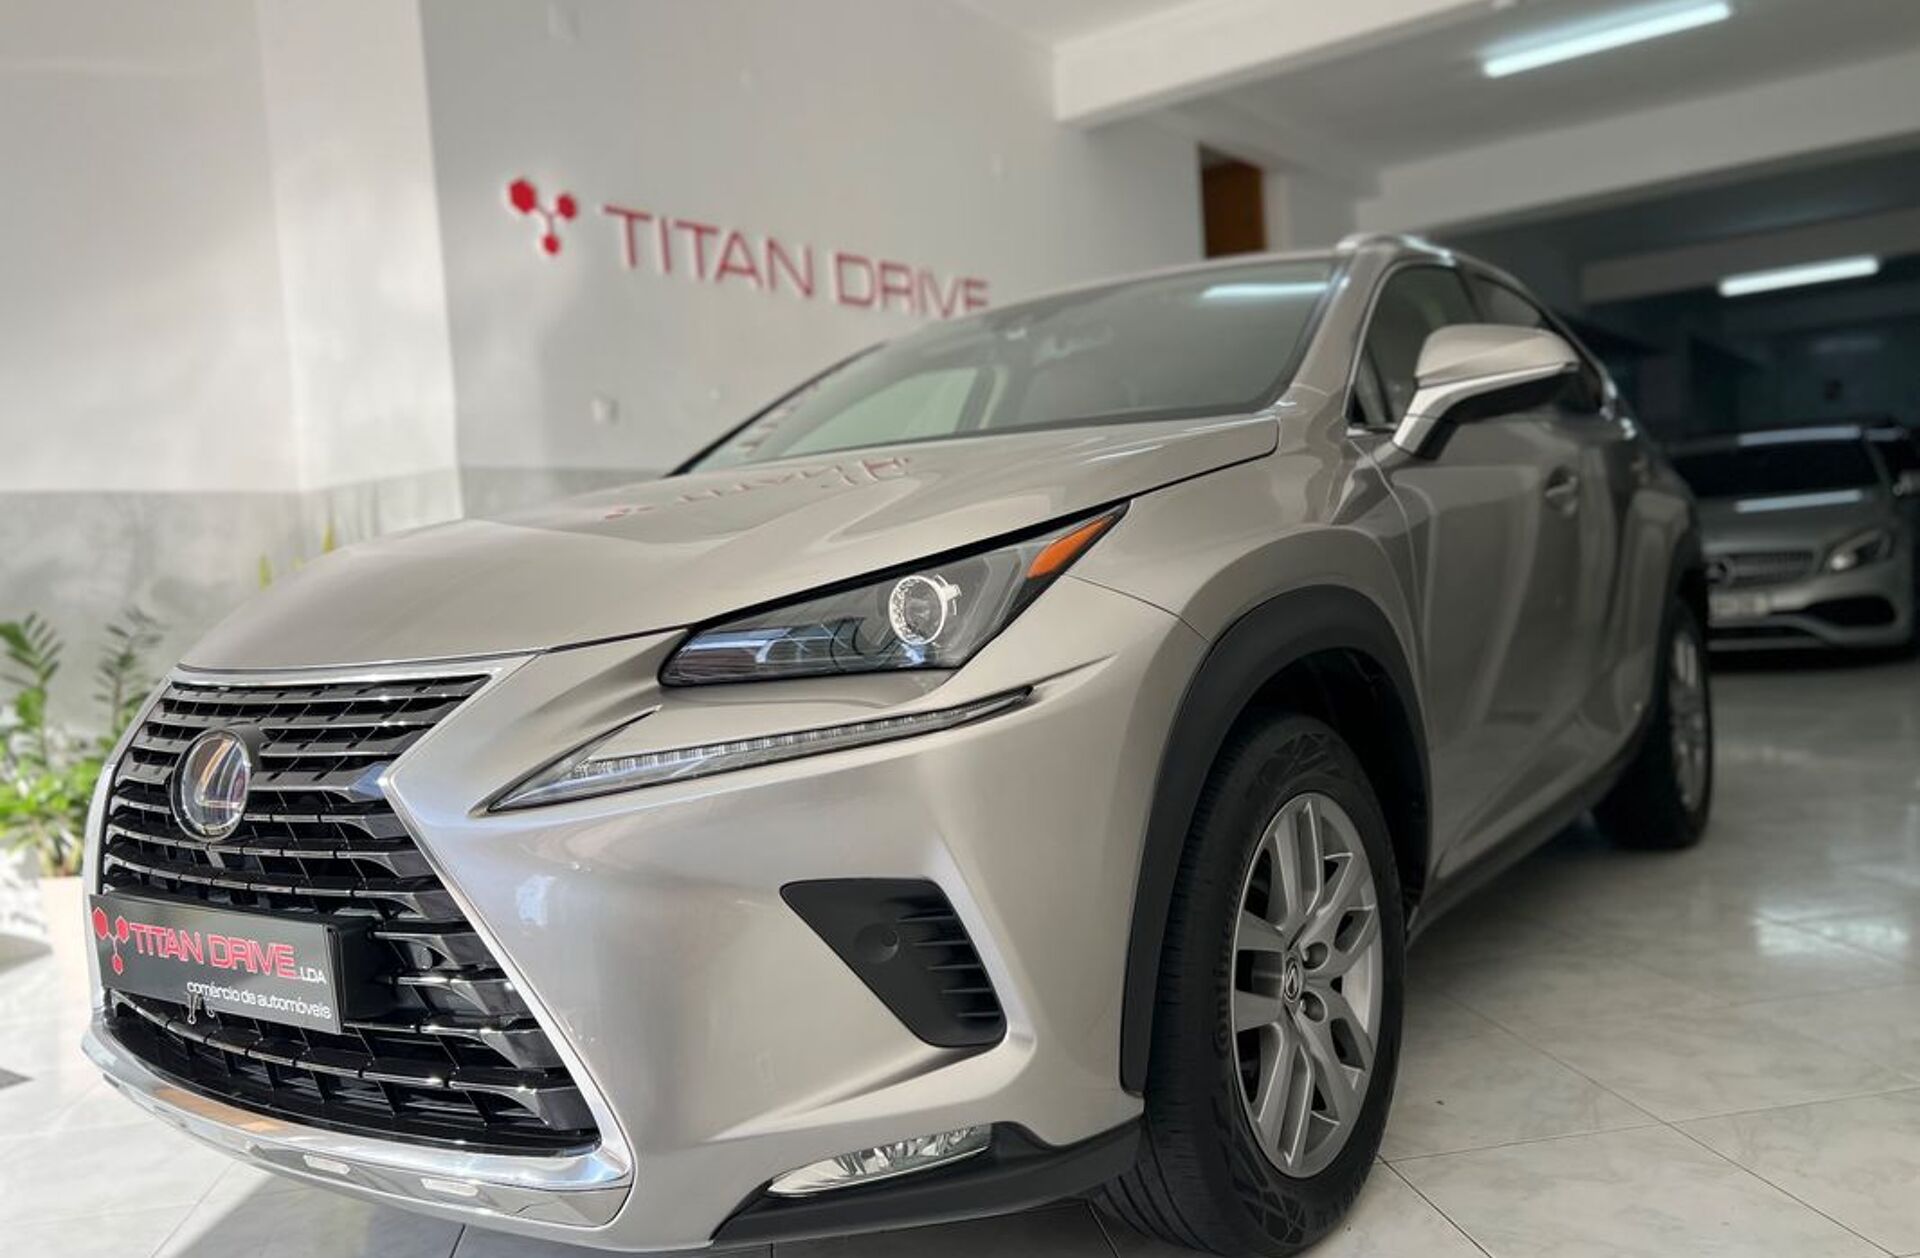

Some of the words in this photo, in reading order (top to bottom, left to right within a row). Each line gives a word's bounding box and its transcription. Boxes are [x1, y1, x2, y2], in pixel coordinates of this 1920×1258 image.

[603, 204, 815, 299] TITAN
[835, 252, 990, 319] DRIVE
[129, 922, 204, 966] TITAN
[207, 934, 298, 979] DRIVE
[186, 981, 240, 1002] comércio
[240, 989, 257, 1005] de
[257, 994, 333, 1019] automóveis
